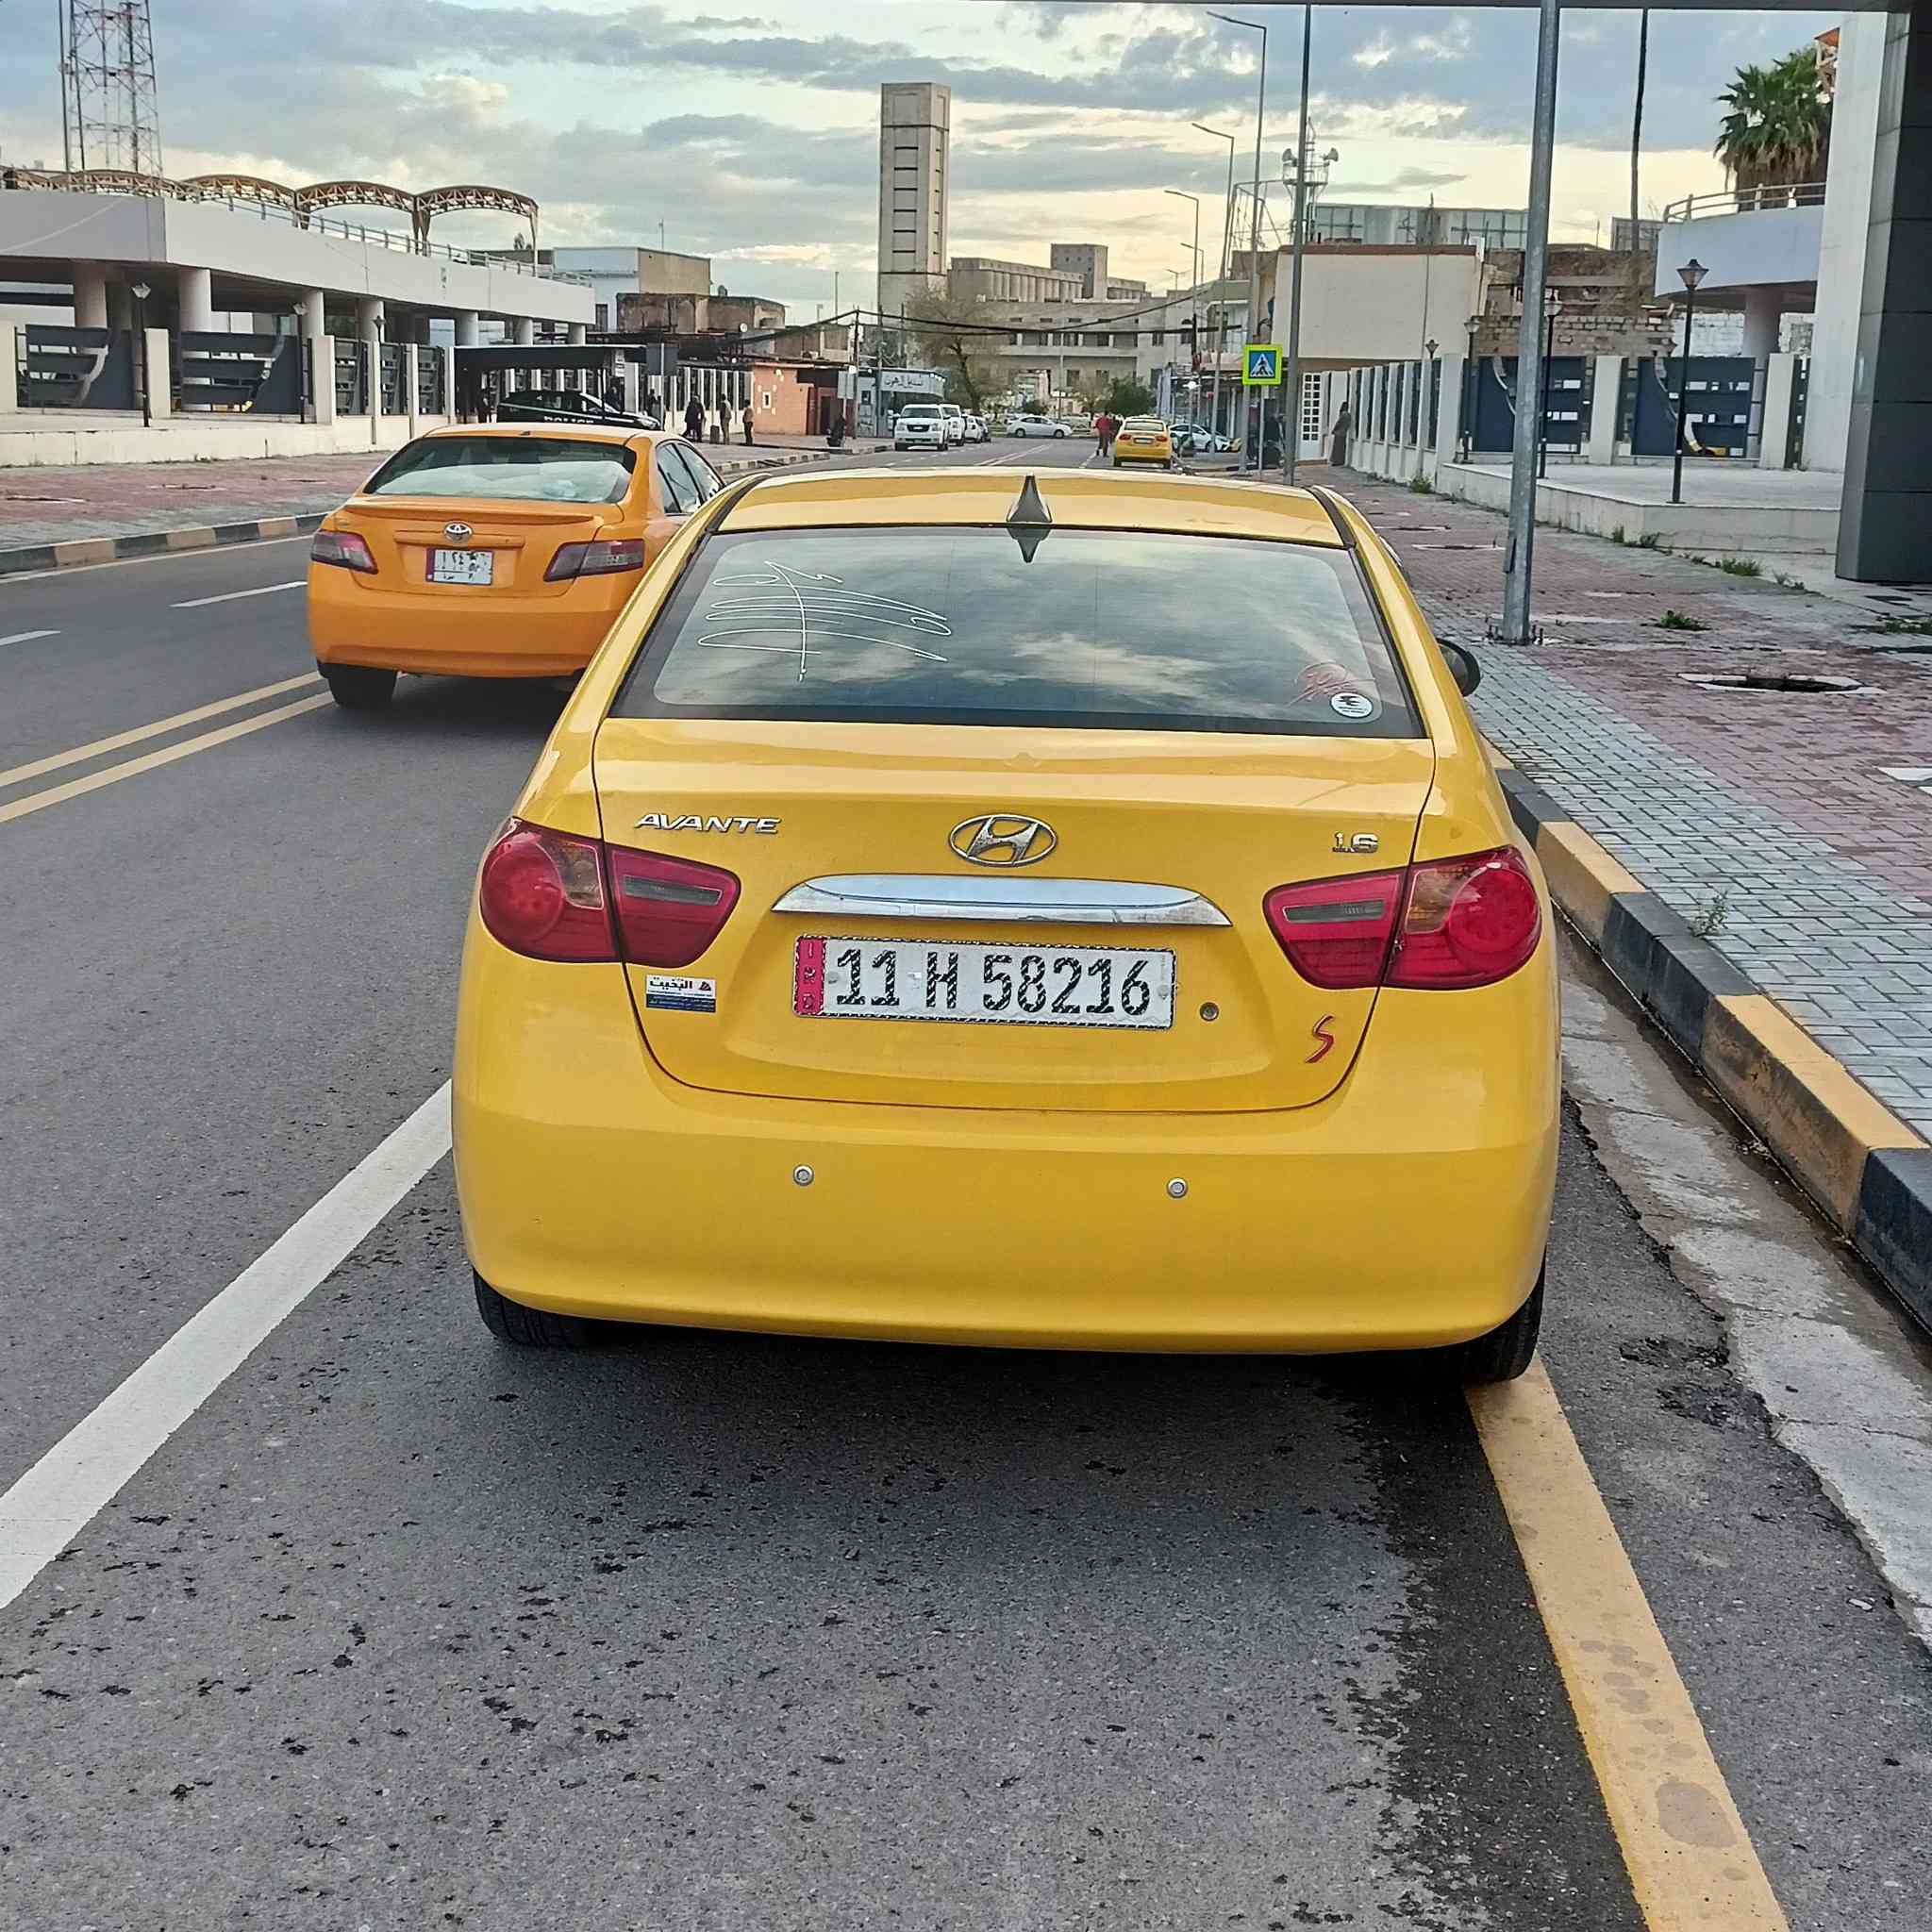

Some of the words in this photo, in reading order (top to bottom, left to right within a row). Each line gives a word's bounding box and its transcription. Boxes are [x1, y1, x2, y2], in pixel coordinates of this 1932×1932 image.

[634, 813, 782, 835] AVANTE
[1332, 831, 1378, 853] 1.6
[837, 948, 900, 1006] 11
[926, 951, 958, 1008] H
[982, 954, 1151, 1016] 58216
